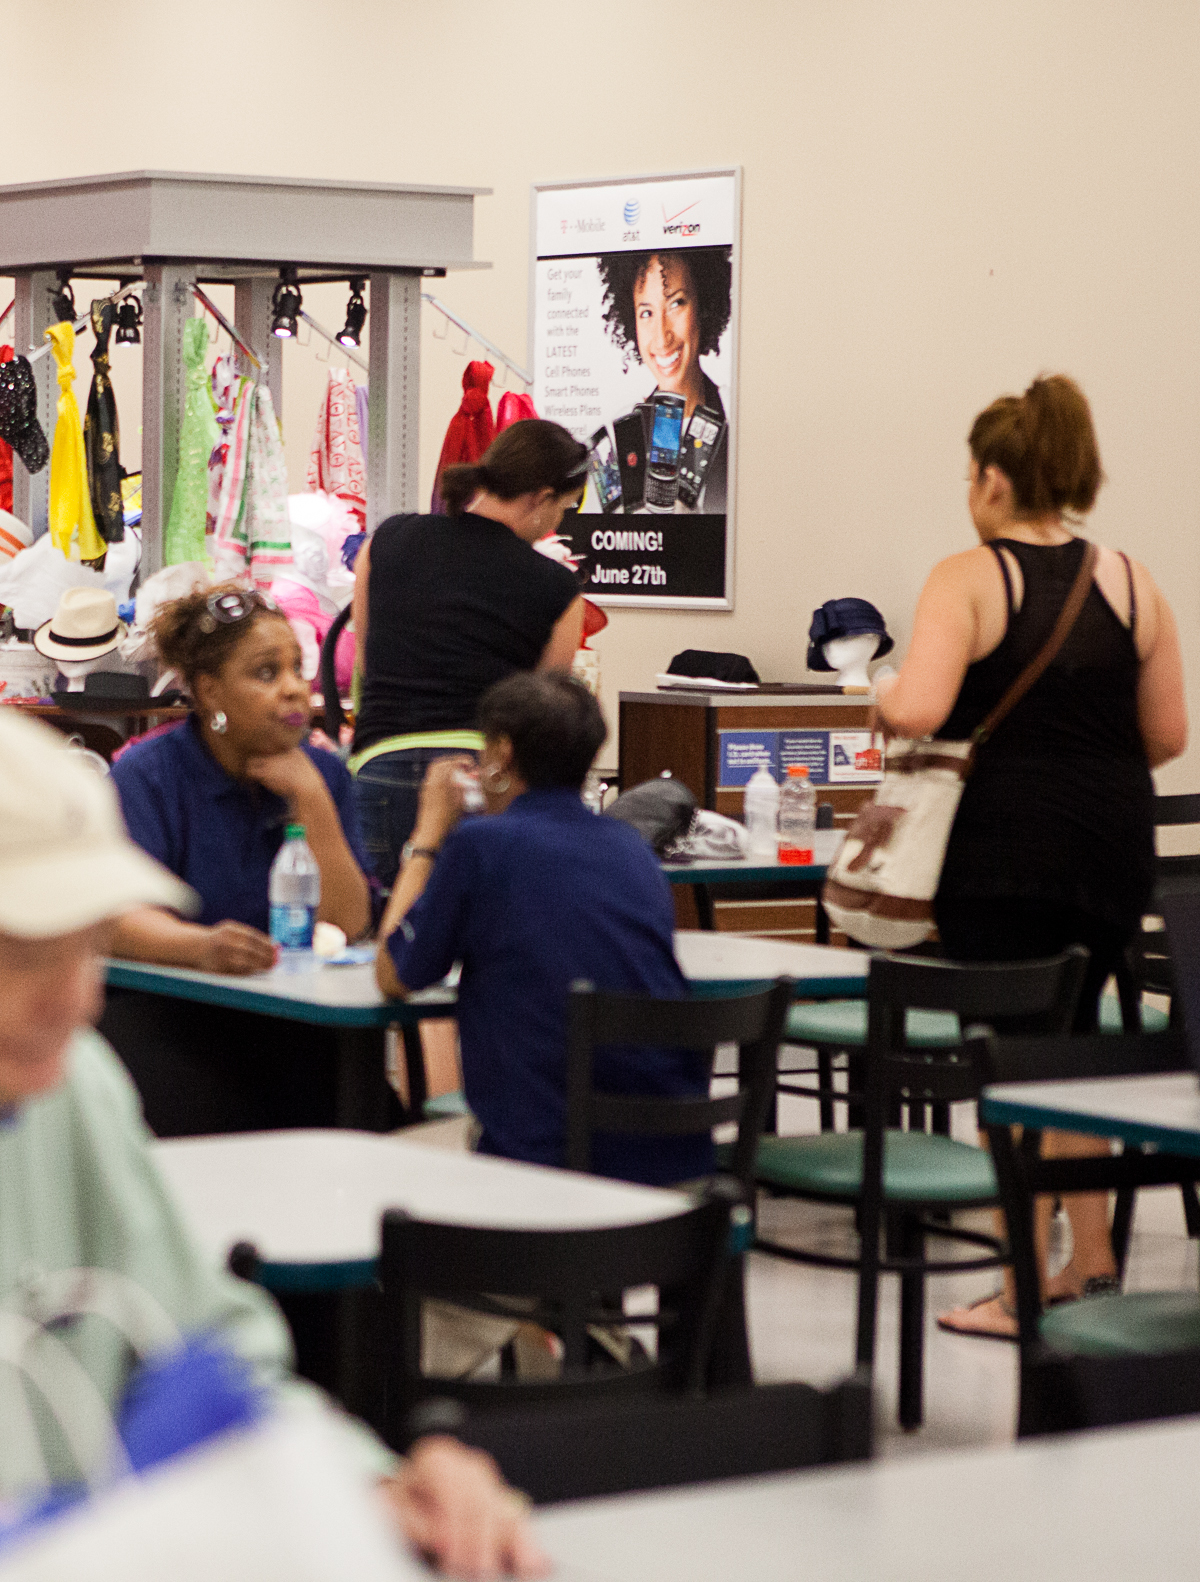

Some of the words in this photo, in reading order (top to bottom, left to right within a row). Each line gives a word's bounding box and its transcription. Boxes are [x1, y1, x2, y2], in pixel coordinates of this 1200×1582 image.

[662, 221, 701, 237] verizon
[546, 268, 562, 281] Get
[563, 269, 583, 284] your
[547, 287, 572, 304] family
[547, 305, 590, 320] connected
[546, 325, 564, 337] with
[566, 325, 579, 336] the
[545, 345, 578, 358] LATEST
[545, 366, 560, 378] Cell
[562, 365, 591, 377] Phones
[544, 385, 568, 398] Smart
[570, 385, 600, 397] Phones
[544, 404, 578, 417] Wireless
[580, 404, 602, 417] Plans
[591, 530, 664, 551] COMING!
[591, 564, 630, 584] June
[631, 564, 667, 585] 27th
